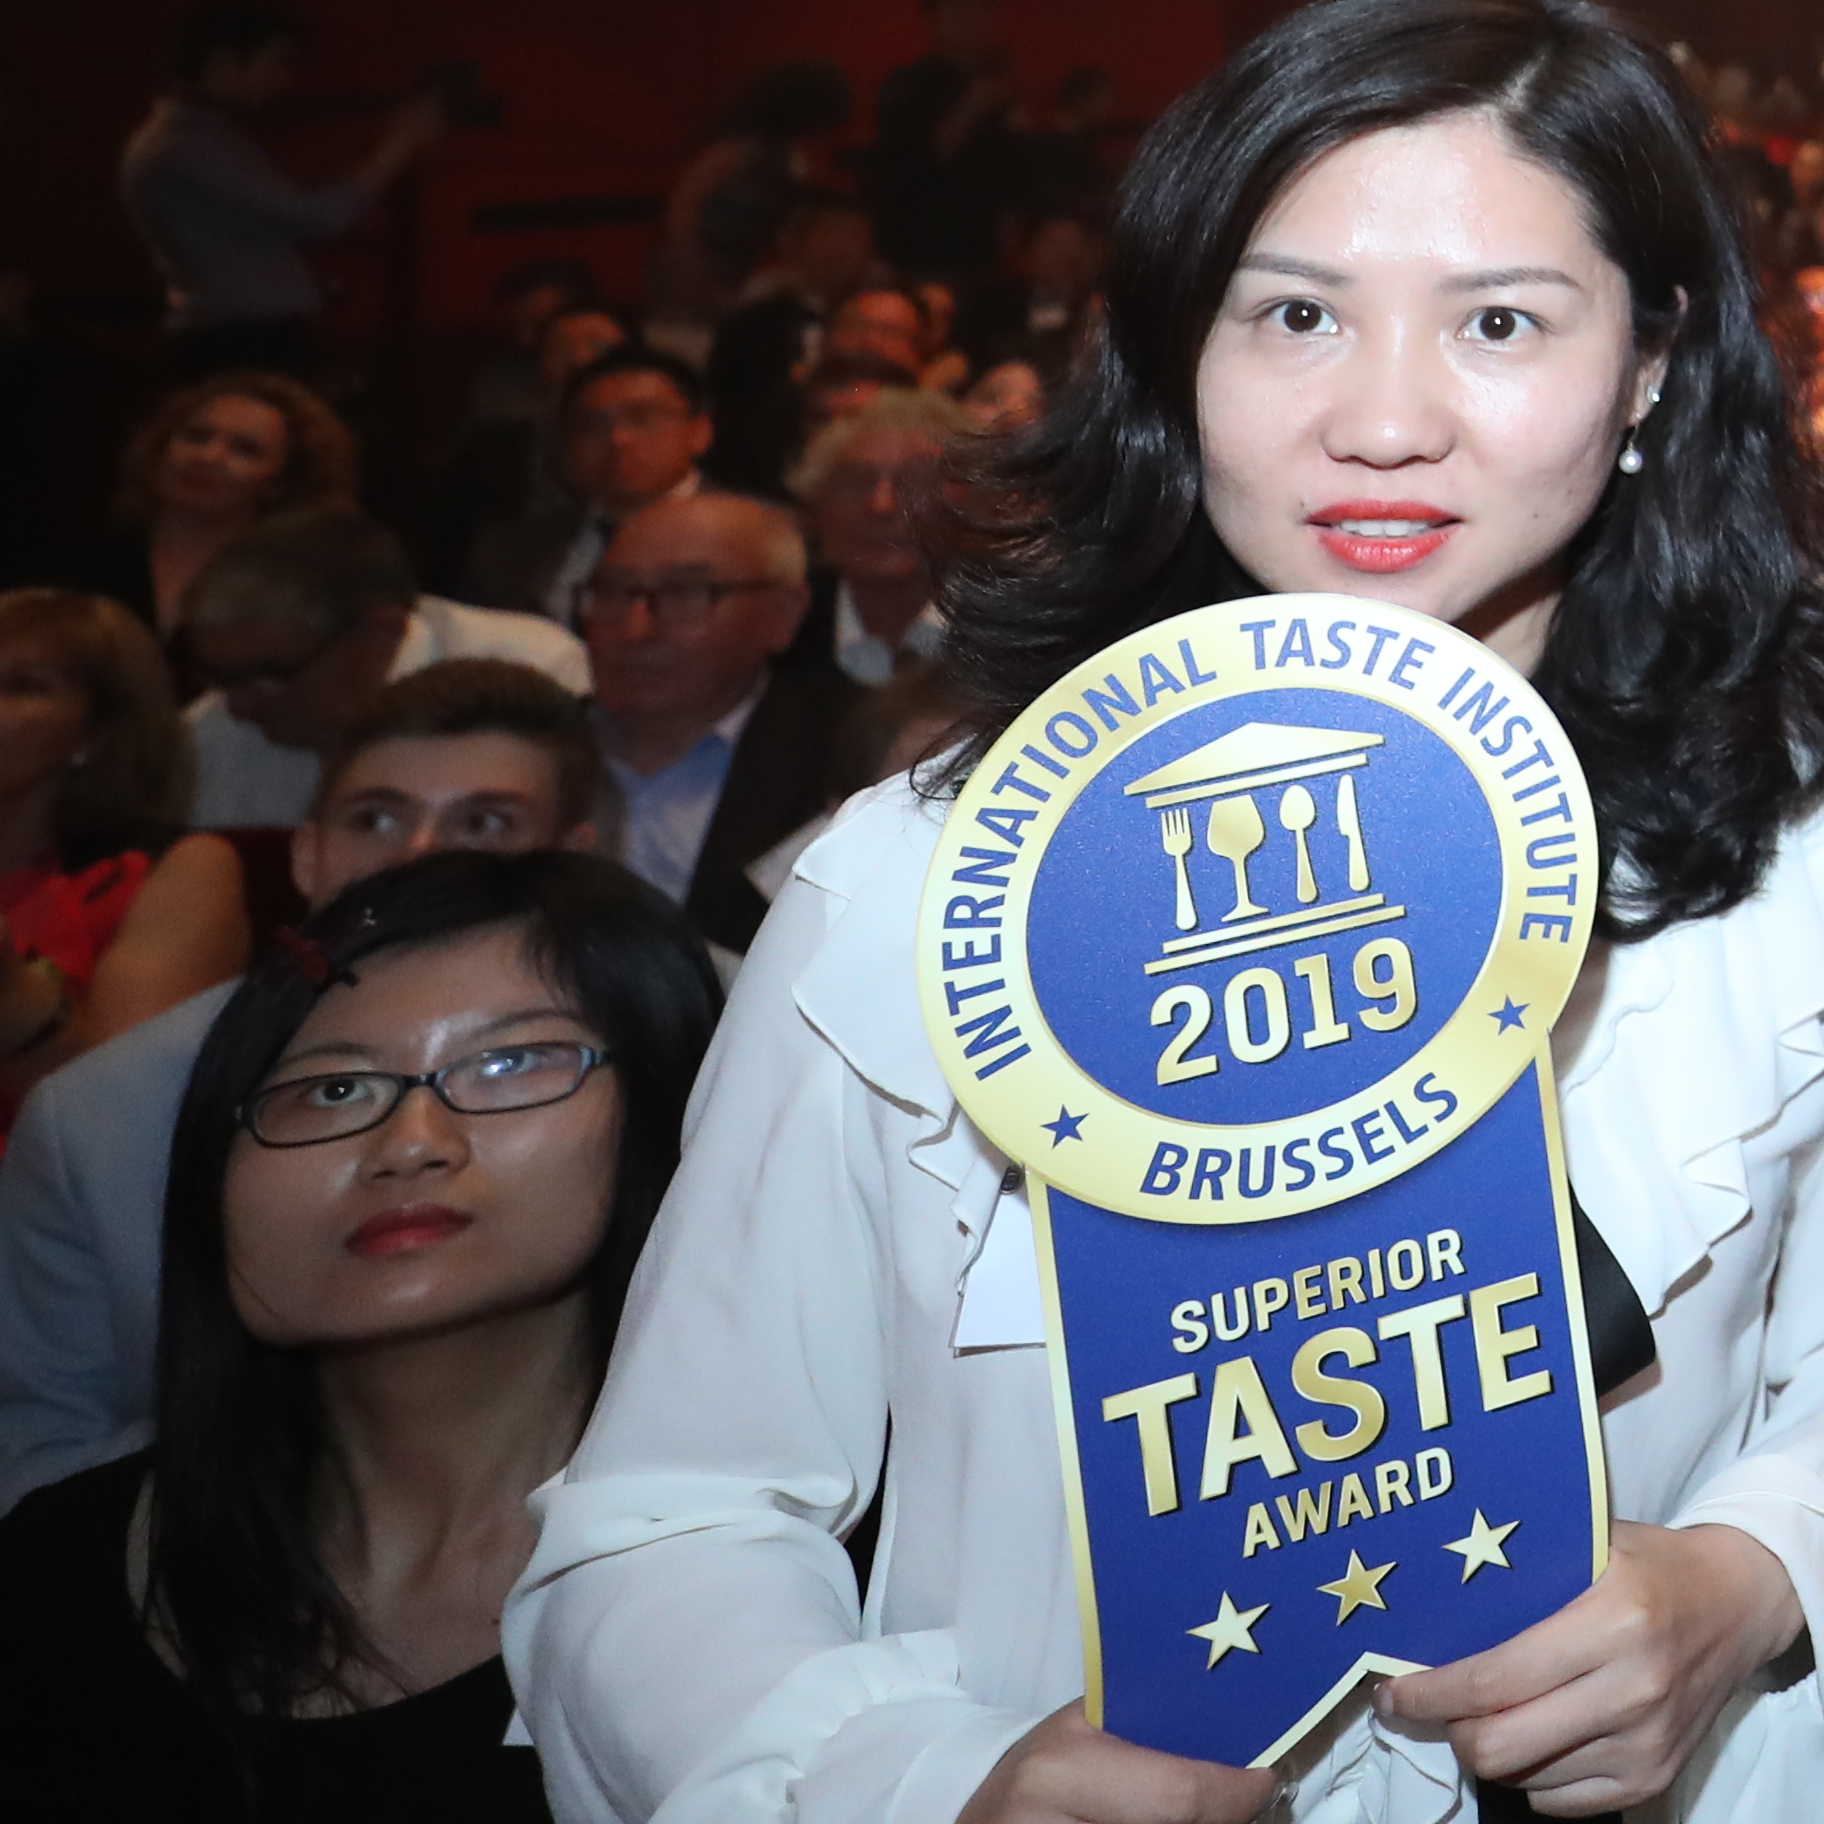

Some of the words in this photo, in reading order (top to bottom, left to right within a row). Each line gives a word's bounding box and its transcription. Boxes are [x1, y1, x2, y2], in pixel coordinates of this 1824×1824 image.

[941, 638, 1218, 1081] INTERNATIONAL
[1239, 618, 1436, 692] TASTE
[1437, 665, 1580, 944] INSTITUTE
[1149, 936, 1419, 1086] 2019
[1140, 1070, 1459, 1202] BRUSSELS
[1169, 1227, 1465, 1355] SUPERIOR
[1102, 1272, 1552, 1517] TASTE
[1242, 1446, 1454, 1559] AWARD
